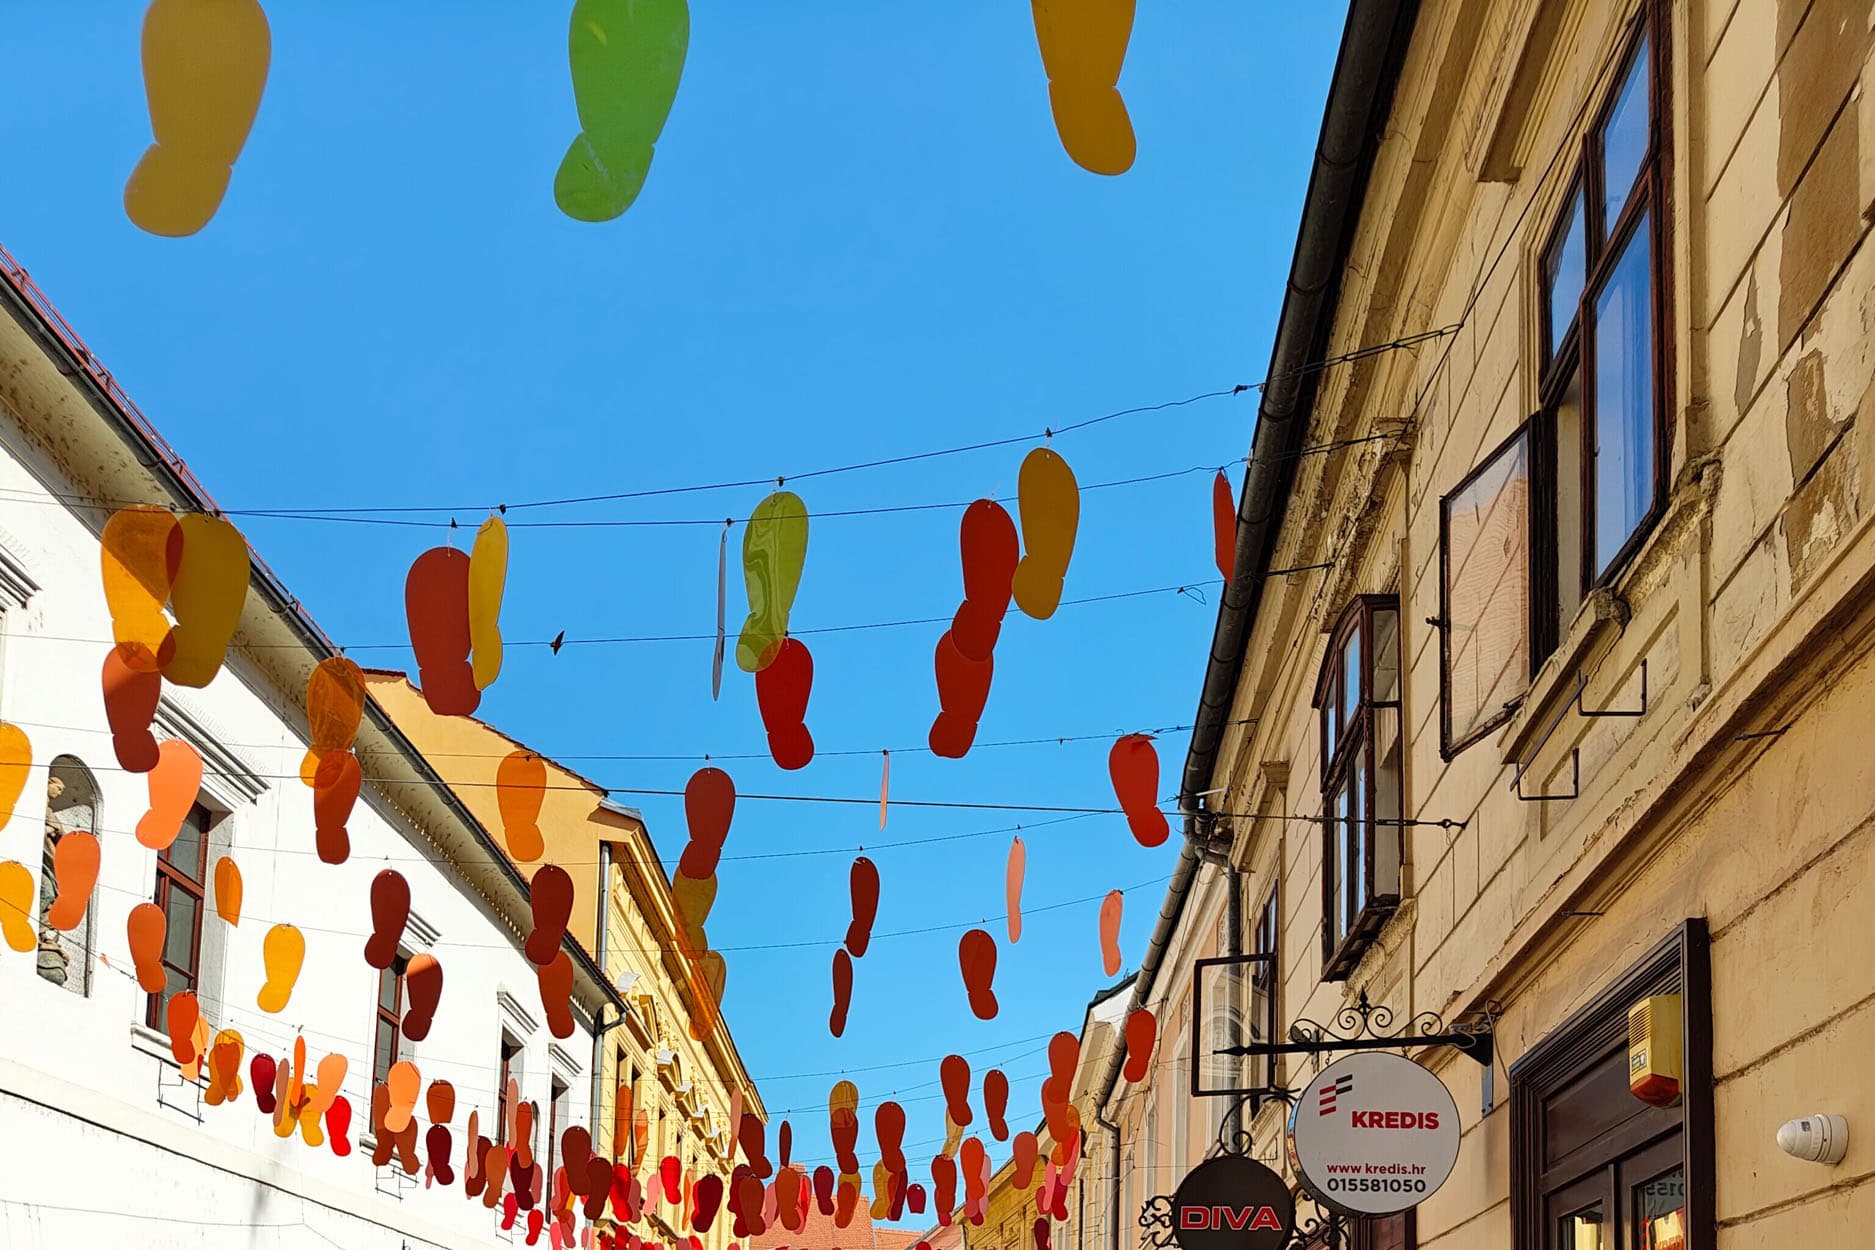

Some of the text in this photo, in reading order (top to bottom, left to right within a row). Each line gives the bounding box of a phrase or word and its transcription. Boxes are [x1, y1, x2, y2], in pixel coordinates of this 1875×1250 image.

[1352, 1111, 1439, 1130] KREDIS
[1327, 1178, 1426, 1193] 015581050
[1180, 1205, 1283, 1231] DIVA
